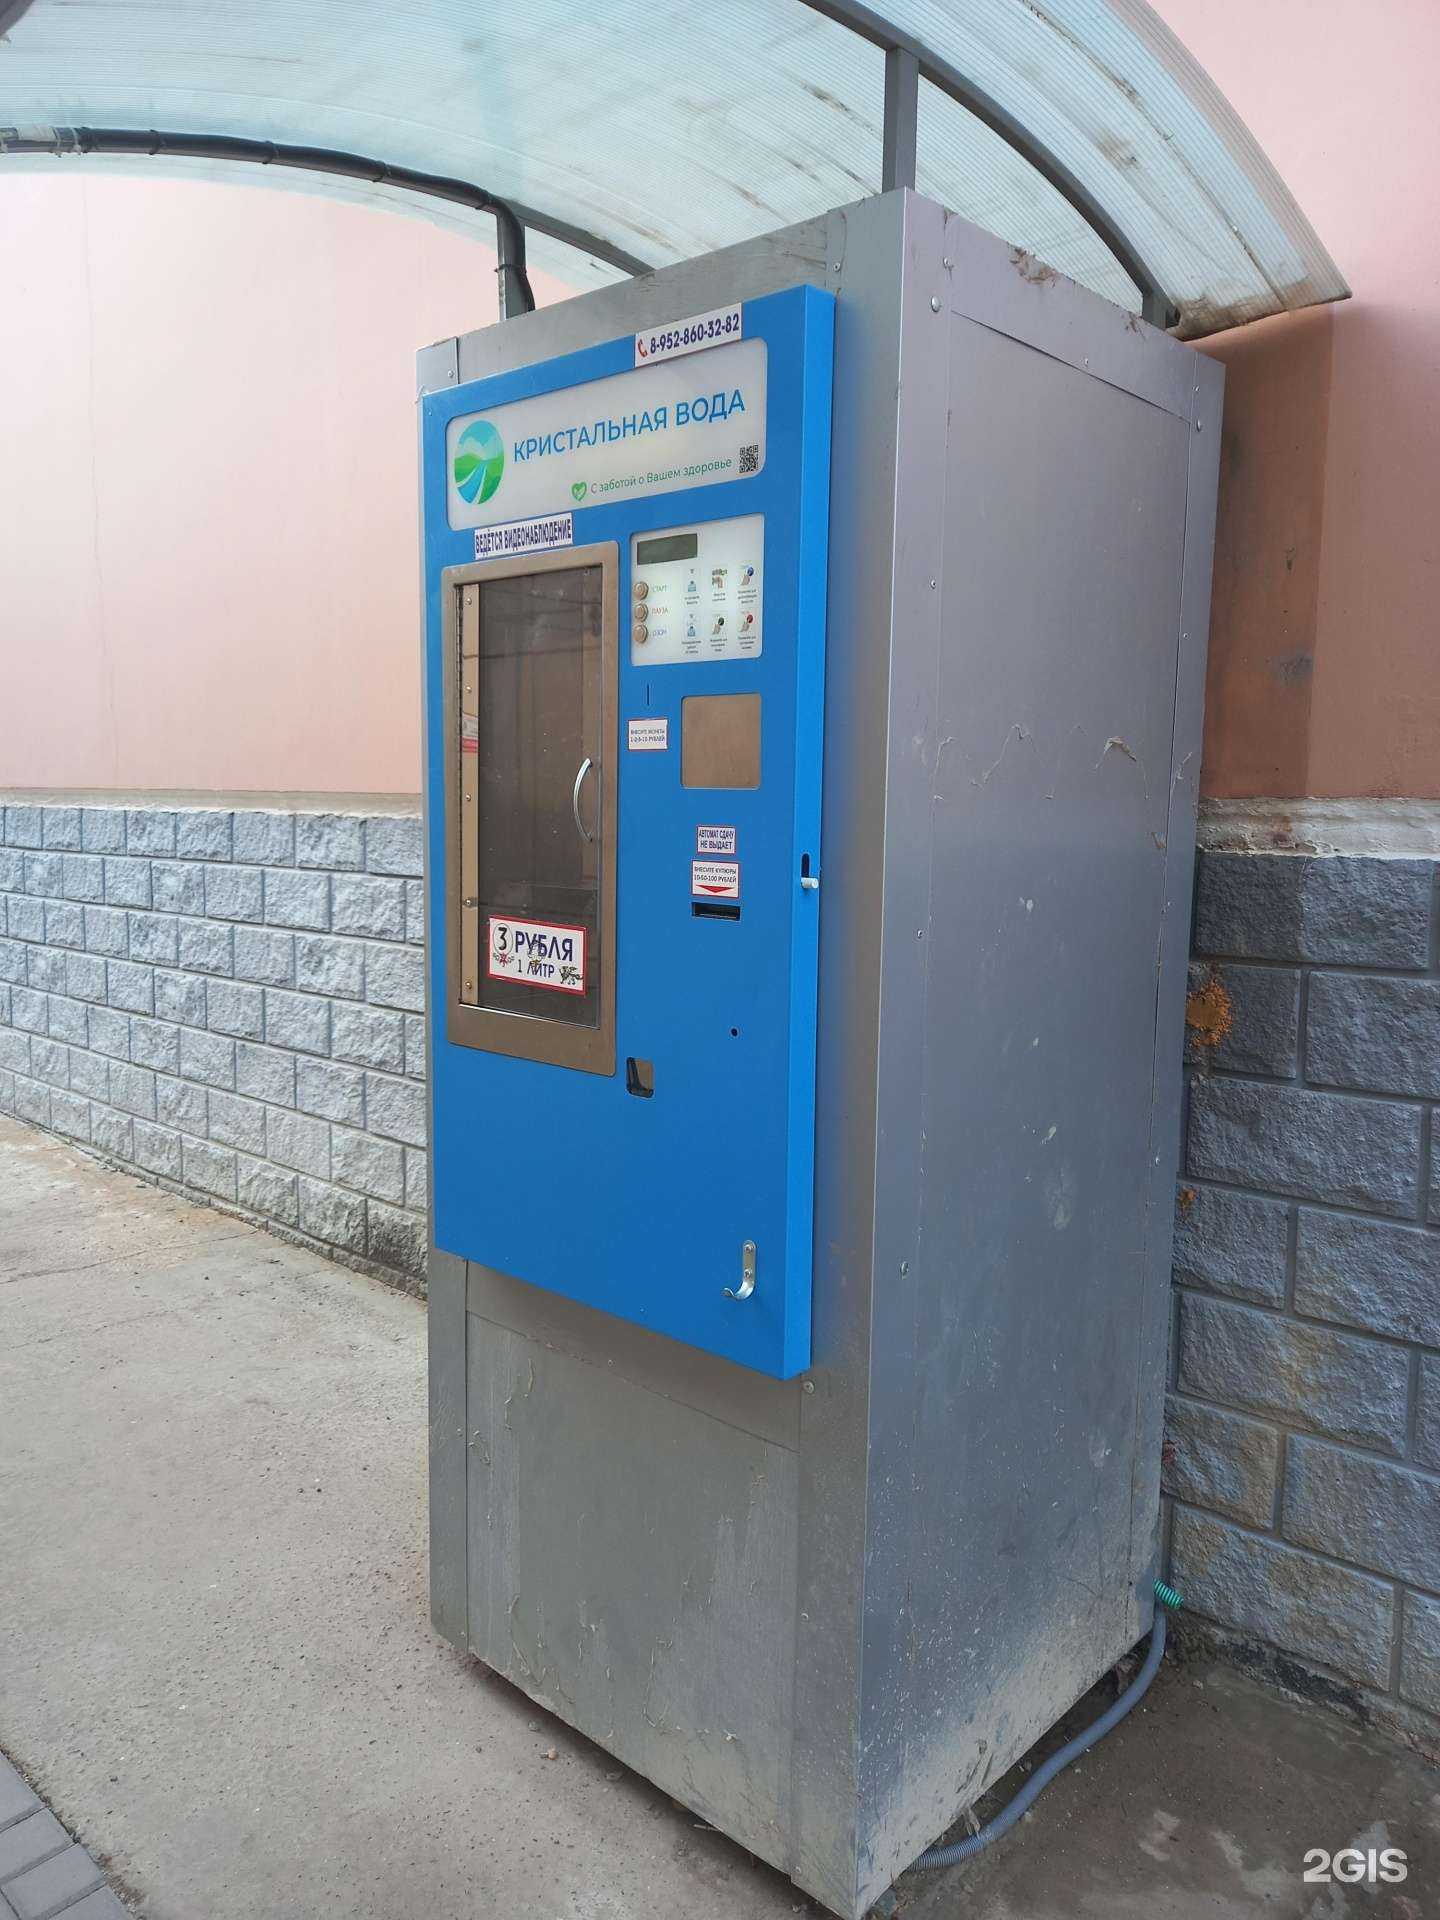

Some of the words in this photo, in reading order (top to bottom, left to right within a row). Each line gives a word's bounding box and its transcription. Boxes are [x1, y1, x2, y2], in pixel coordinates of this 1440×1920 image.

[650, 313, 740, 354] 8-952-860-32-82
[514, 408, 667, 462] КРИСТАЛЬНАЯ
[676, 389, 746, 425] ВОДА
[591, 482, 598, 494] С
[599, 474, 637, 493] заботой
[638, 476, 646, 486] о
[647, 468, 681, 484] Вашем
[683, 457, 733, 478] здоровье
[475, 529, 502, 553] ВЕДЁТСЯ
[504, 519, 572, 550] ВИДЕОНАБЛЮДЕНИЕ
[699, 830, 719, 838] АВТОМАТ
[720, 830, 734, 839] СДАЧУ
[709, 841, 733, 850] ВЫДАЕТ
[694, 866, 715, 874] ВНЕСИТЕ
[694, 874, 718, 882] 10-50-100
[718, 875, 736, 883] РУБЛЕЙ
[498, 926, 508, 951] 3
[515, 930, 573, 962] РУБЛЯ
[518, 959, 523, 973] 1
[527, 961, 555, 979] ЛИТР
